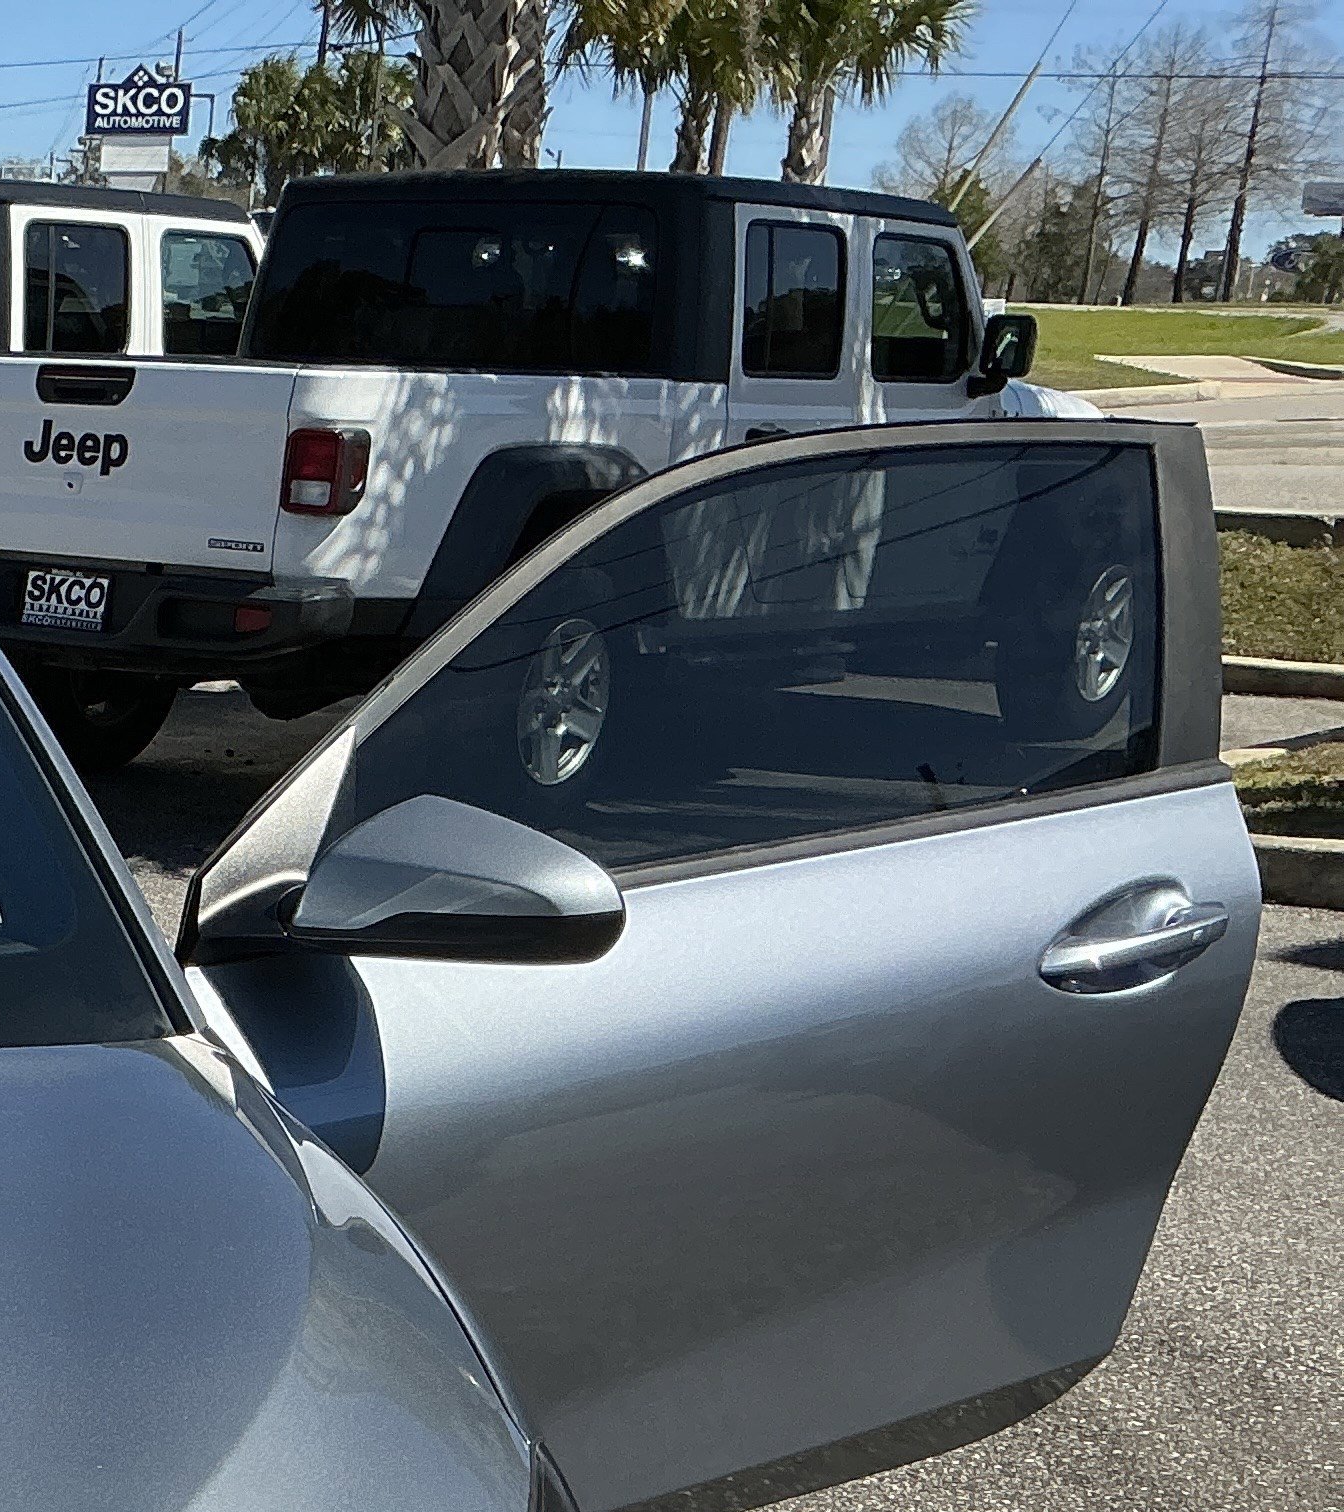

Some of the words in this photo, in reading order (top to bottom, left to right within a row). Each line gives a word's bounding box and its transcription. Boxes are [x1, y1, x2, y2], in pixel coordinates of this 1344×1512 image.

[93, 87, 185, 115] SKCO
[94, 116, 182, 128] AUTOMOTIVE
[23, 419, 129, 476] Jeep
[27, 574, 106, 609] SKCO
